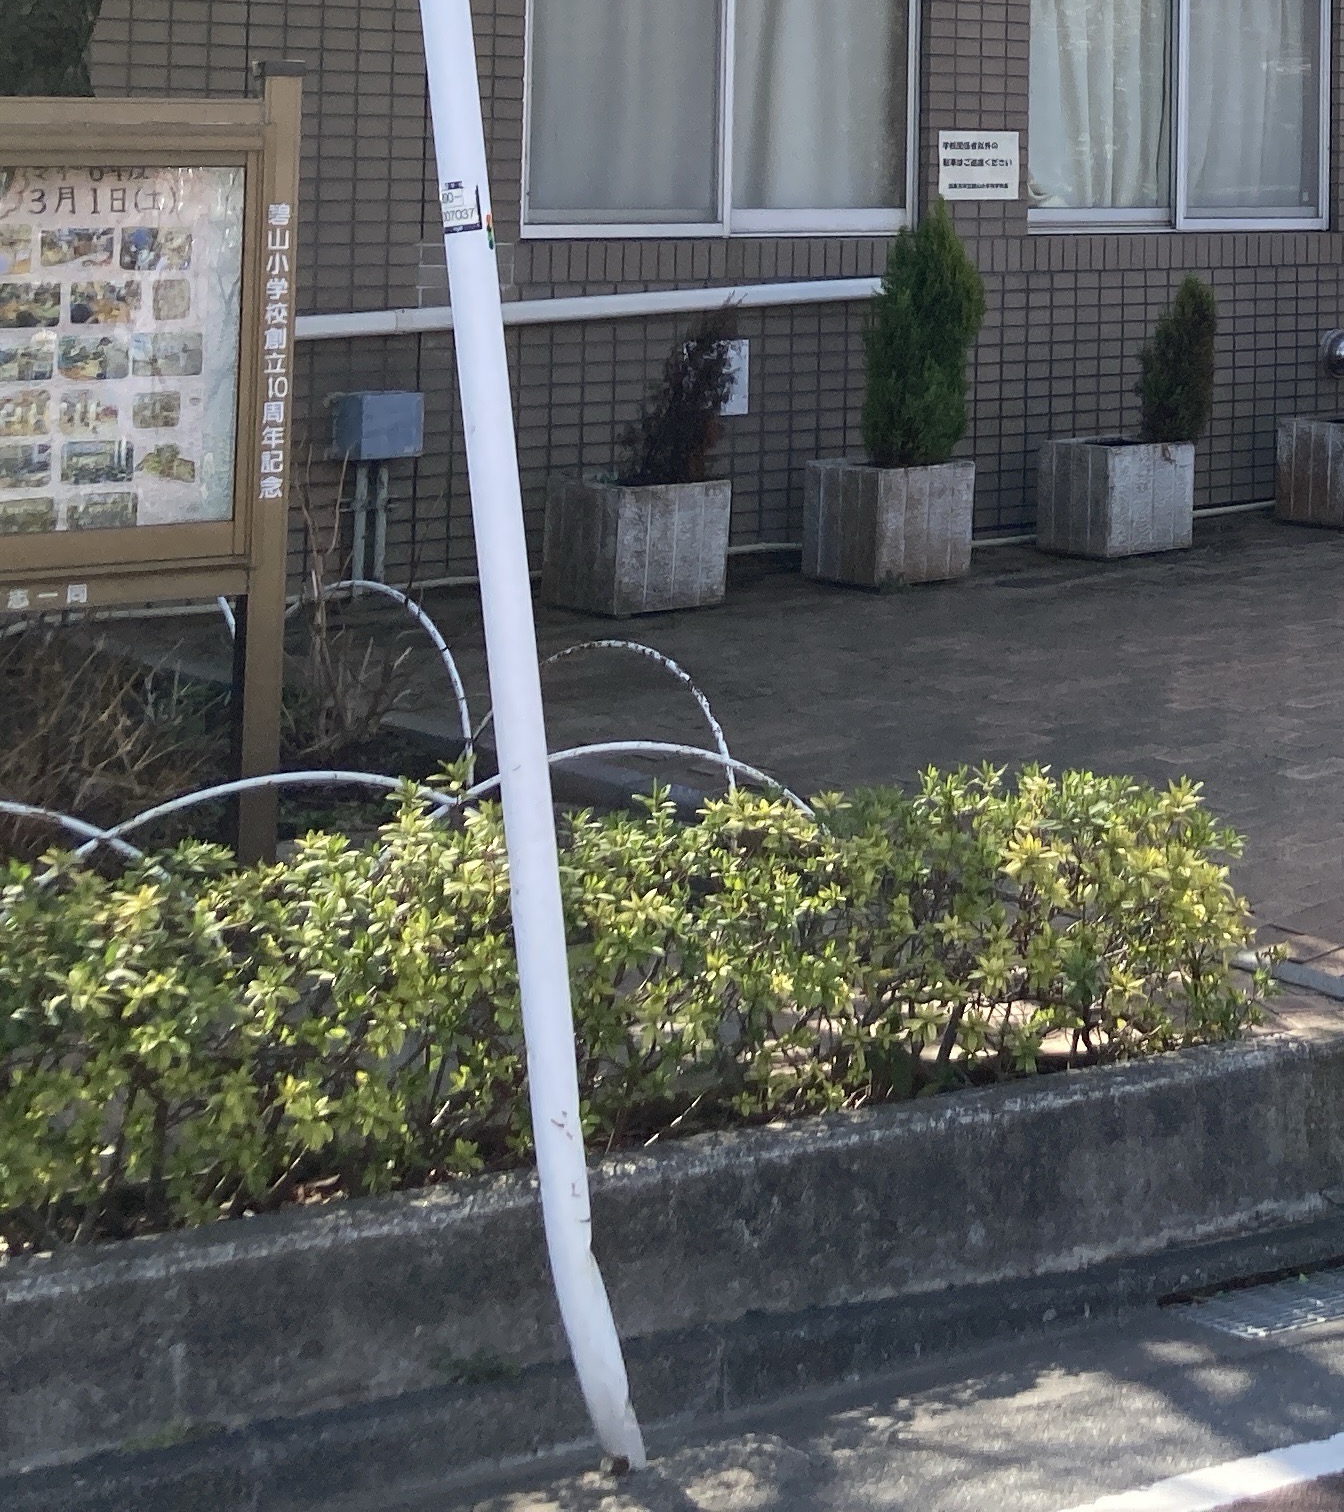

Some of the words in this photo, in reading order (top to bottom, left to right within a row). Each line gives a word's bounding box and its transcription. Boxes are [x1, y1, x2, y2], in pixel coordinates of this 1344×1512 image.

[258, 203, 292, 500] 碧山小学校創立10周年記念
